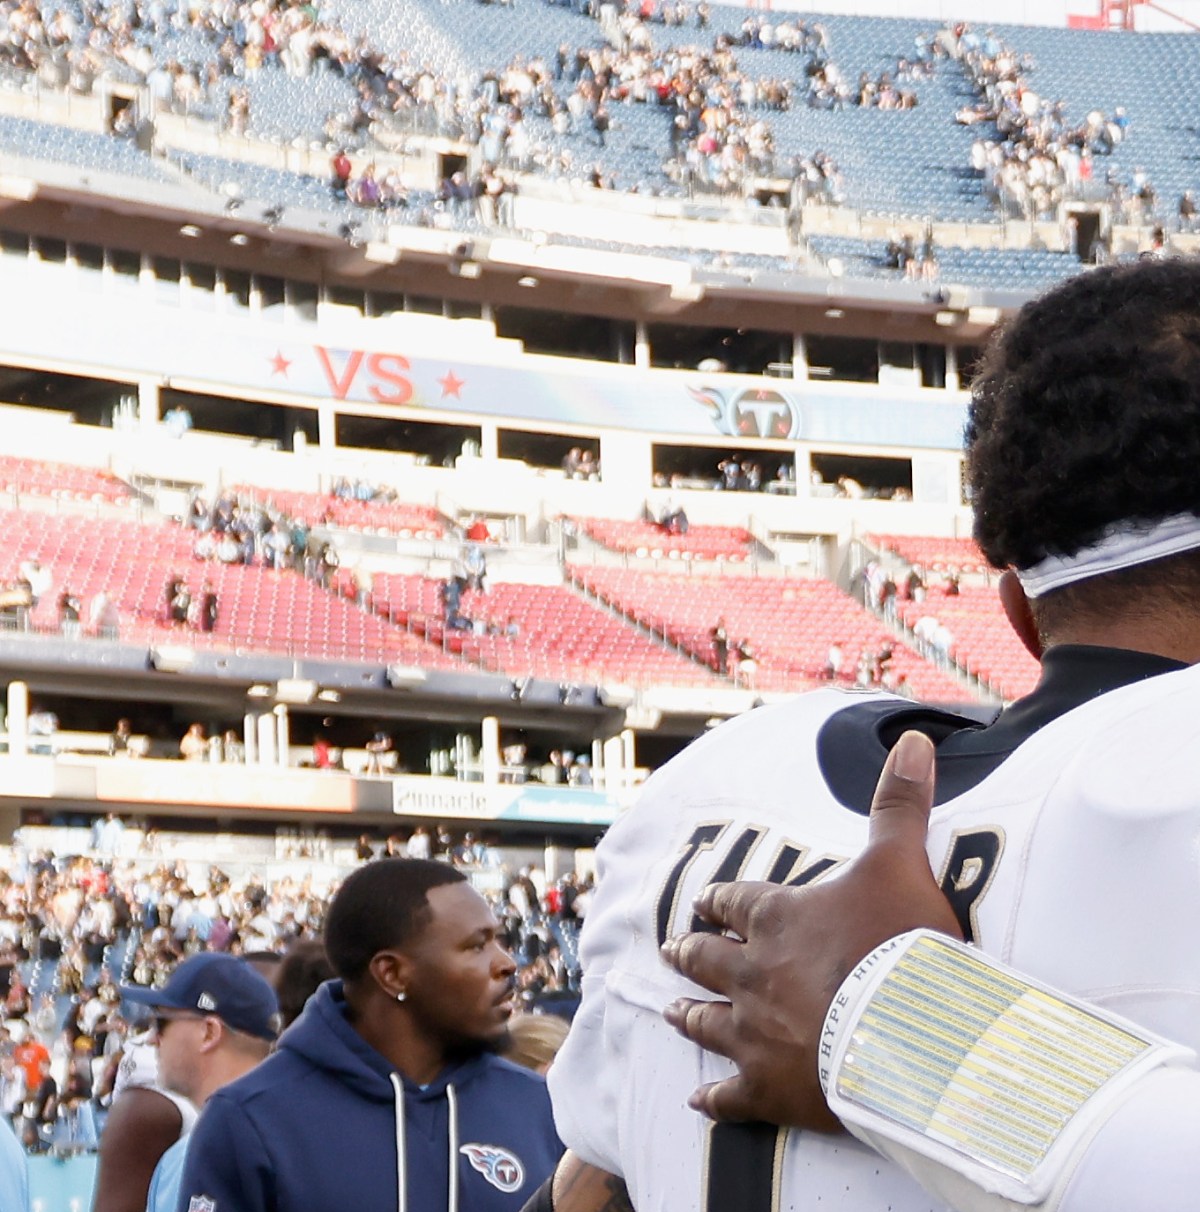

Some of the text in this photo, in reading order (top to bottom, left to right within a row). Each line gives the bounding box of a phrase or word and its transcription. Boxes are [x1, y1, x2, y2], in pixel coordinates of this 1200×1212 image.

[314, 345, 413, 405] VS
[653, 818, 1006, 948] TAR
[821, 992, 849, 1058] HYPE
